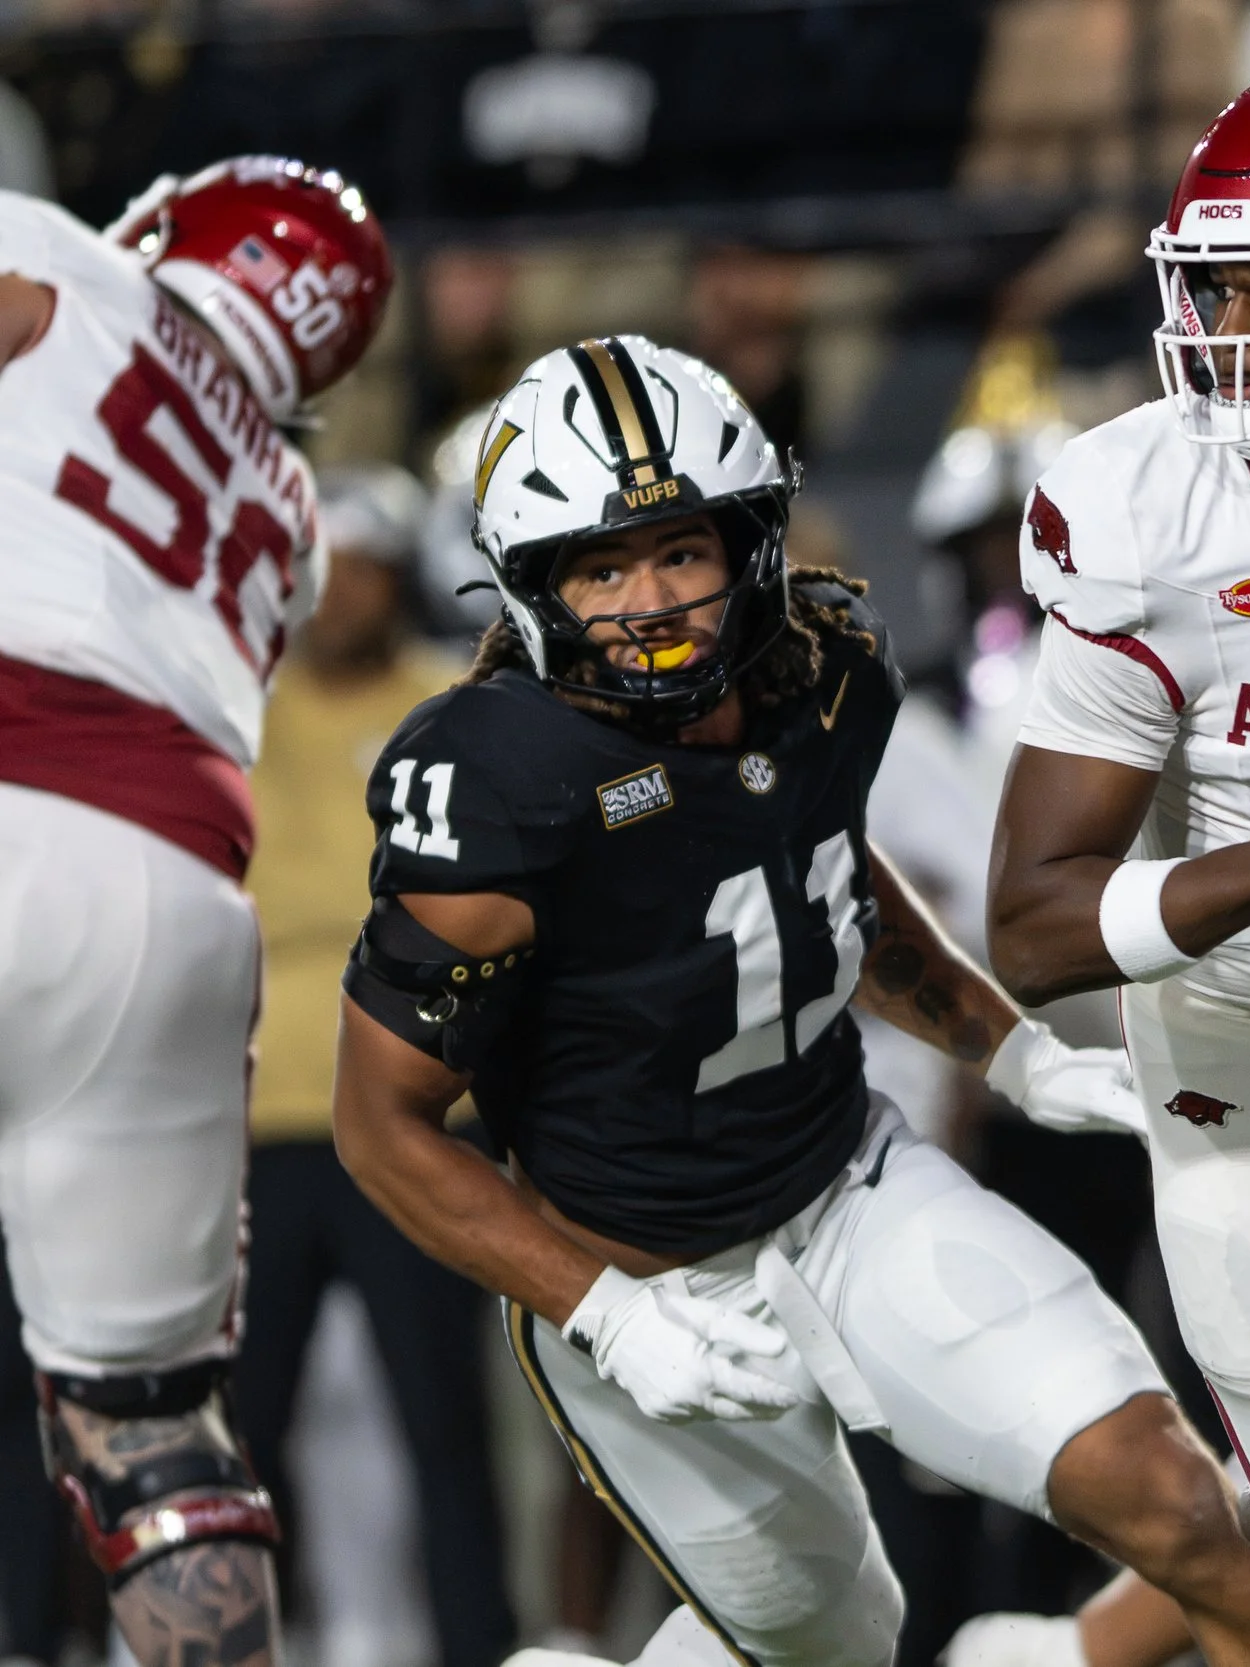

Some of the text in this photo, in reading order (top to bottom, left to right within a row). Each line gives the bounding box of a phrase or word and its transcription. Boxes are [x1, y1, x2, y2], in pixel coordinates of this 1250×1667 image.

[272, 262, 342, 350] 50
[623, 479, 680, 509] VUFB
[613, 771, 667, 810] SRM
[741, 754, 774, 791] SEC
[389, 758, 460, 862] 11
[607, 794, 669, 824] CONCRETE
[694, 828, 864, 1095] 11
